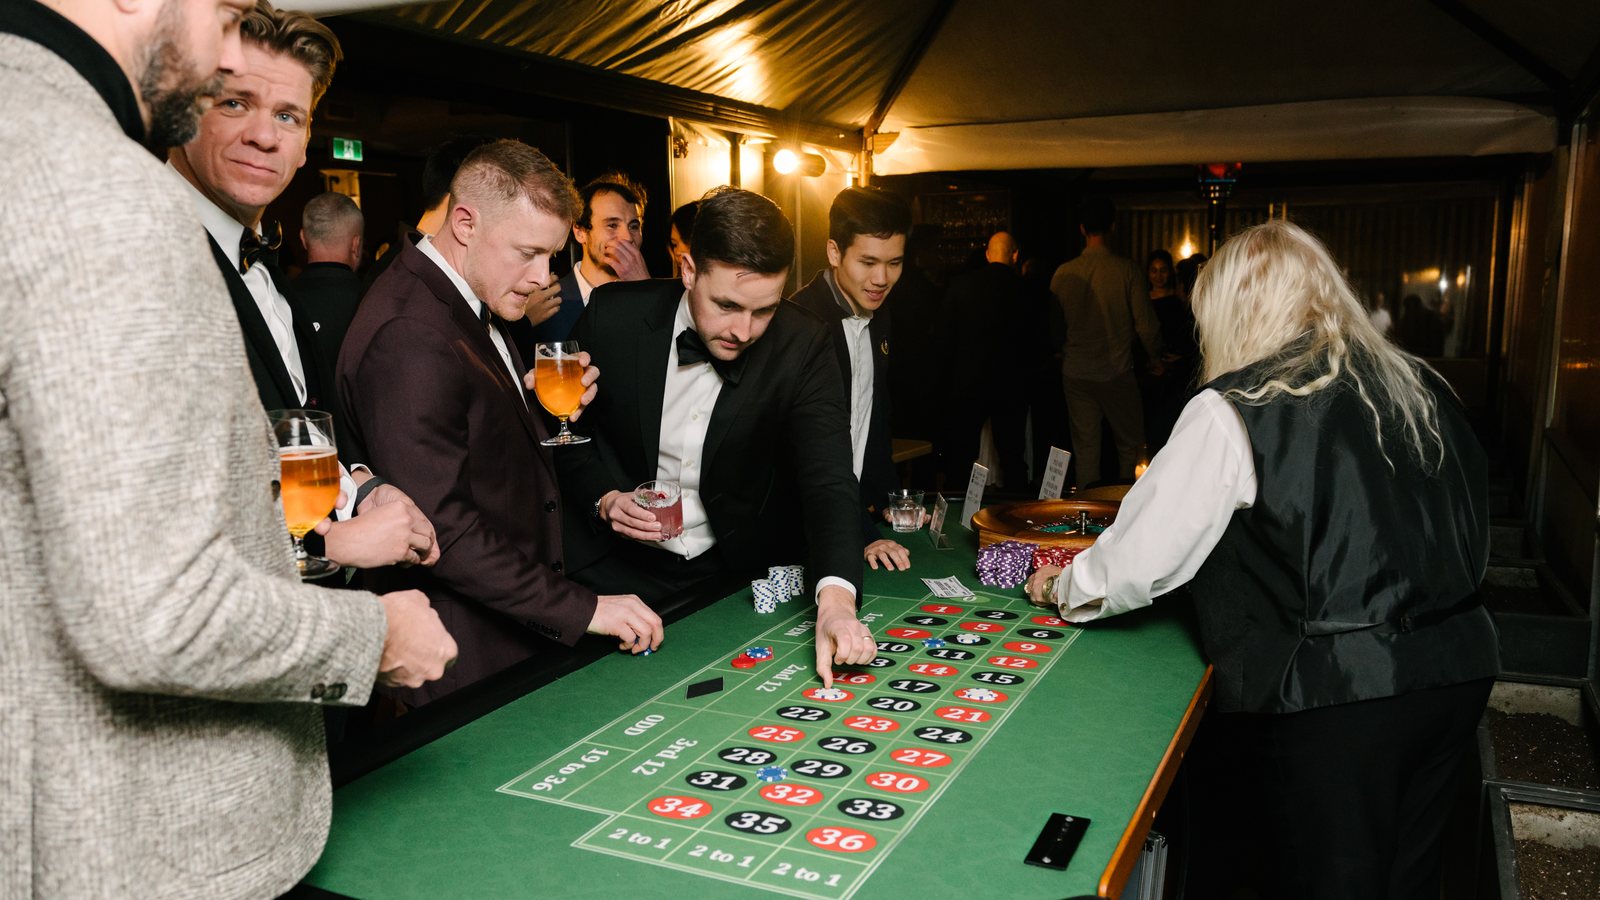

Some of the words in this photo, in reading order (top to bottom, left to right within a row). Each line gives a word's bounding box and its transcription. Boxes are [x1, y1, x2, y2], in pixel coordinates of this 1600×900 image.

[784, 621, 816, 636] EVEN
[877, 642, 908, 651] 10
[870, 658, 890, 667] 3
[932, 650, 967, 660] 11
[992, 657, 1029, 668] 12
[774, 664, 807, 680] 2nd
[833, 673, 869, 683] 16
[912, 665, 948, 675] 14
[755, 680, 782, 692] 12
[894, 681, 933, 691] 17
[977, 673, 1015, 684] 15
[872, 698, 914, 711] 20
[781, 707, 824, 720] 22
[943, 709, 985, 722] 21
[624, 714, 665, 736] ODD
[849, 717, 893, 731] 23
[753, 727, 801, 741] 25
[919, 728, 963, 743] 24
[656, 738, 697, 759] 3rd
[823, 738, 869, 754] 26
[581, 748, 609, 764] 19
[722, 748, 771, 764] 28
[896, 750, 945, 765] 27
[559, 762, 586, 776] to
[632, 758, 666, 776] 12
[795, 761, 844, 777] 29
[532, 774, 566, 791] 36
[690, 772, 737, 790] 31
[871, 774, 920, 791] 30
[765, 785, 814, 804] 32
[653, 797, 705, 817] 34
[845, 800, 897, 819] 33
[730, 812, 786, 833] 35
[608, 828, 628, 839] 2
[628, 831, 653, 845] to
[655, 837, 672, 850] 1
[812, 828, 867, 851] 36
[687, 845, 708, 857] 2
[709, 849, 735, 863] to
[737, 855, 755, 868] 1
[771, 863, 792, 875] 2
[794, 867, 820, 881] to
[824, 873, 842, 886] 1
